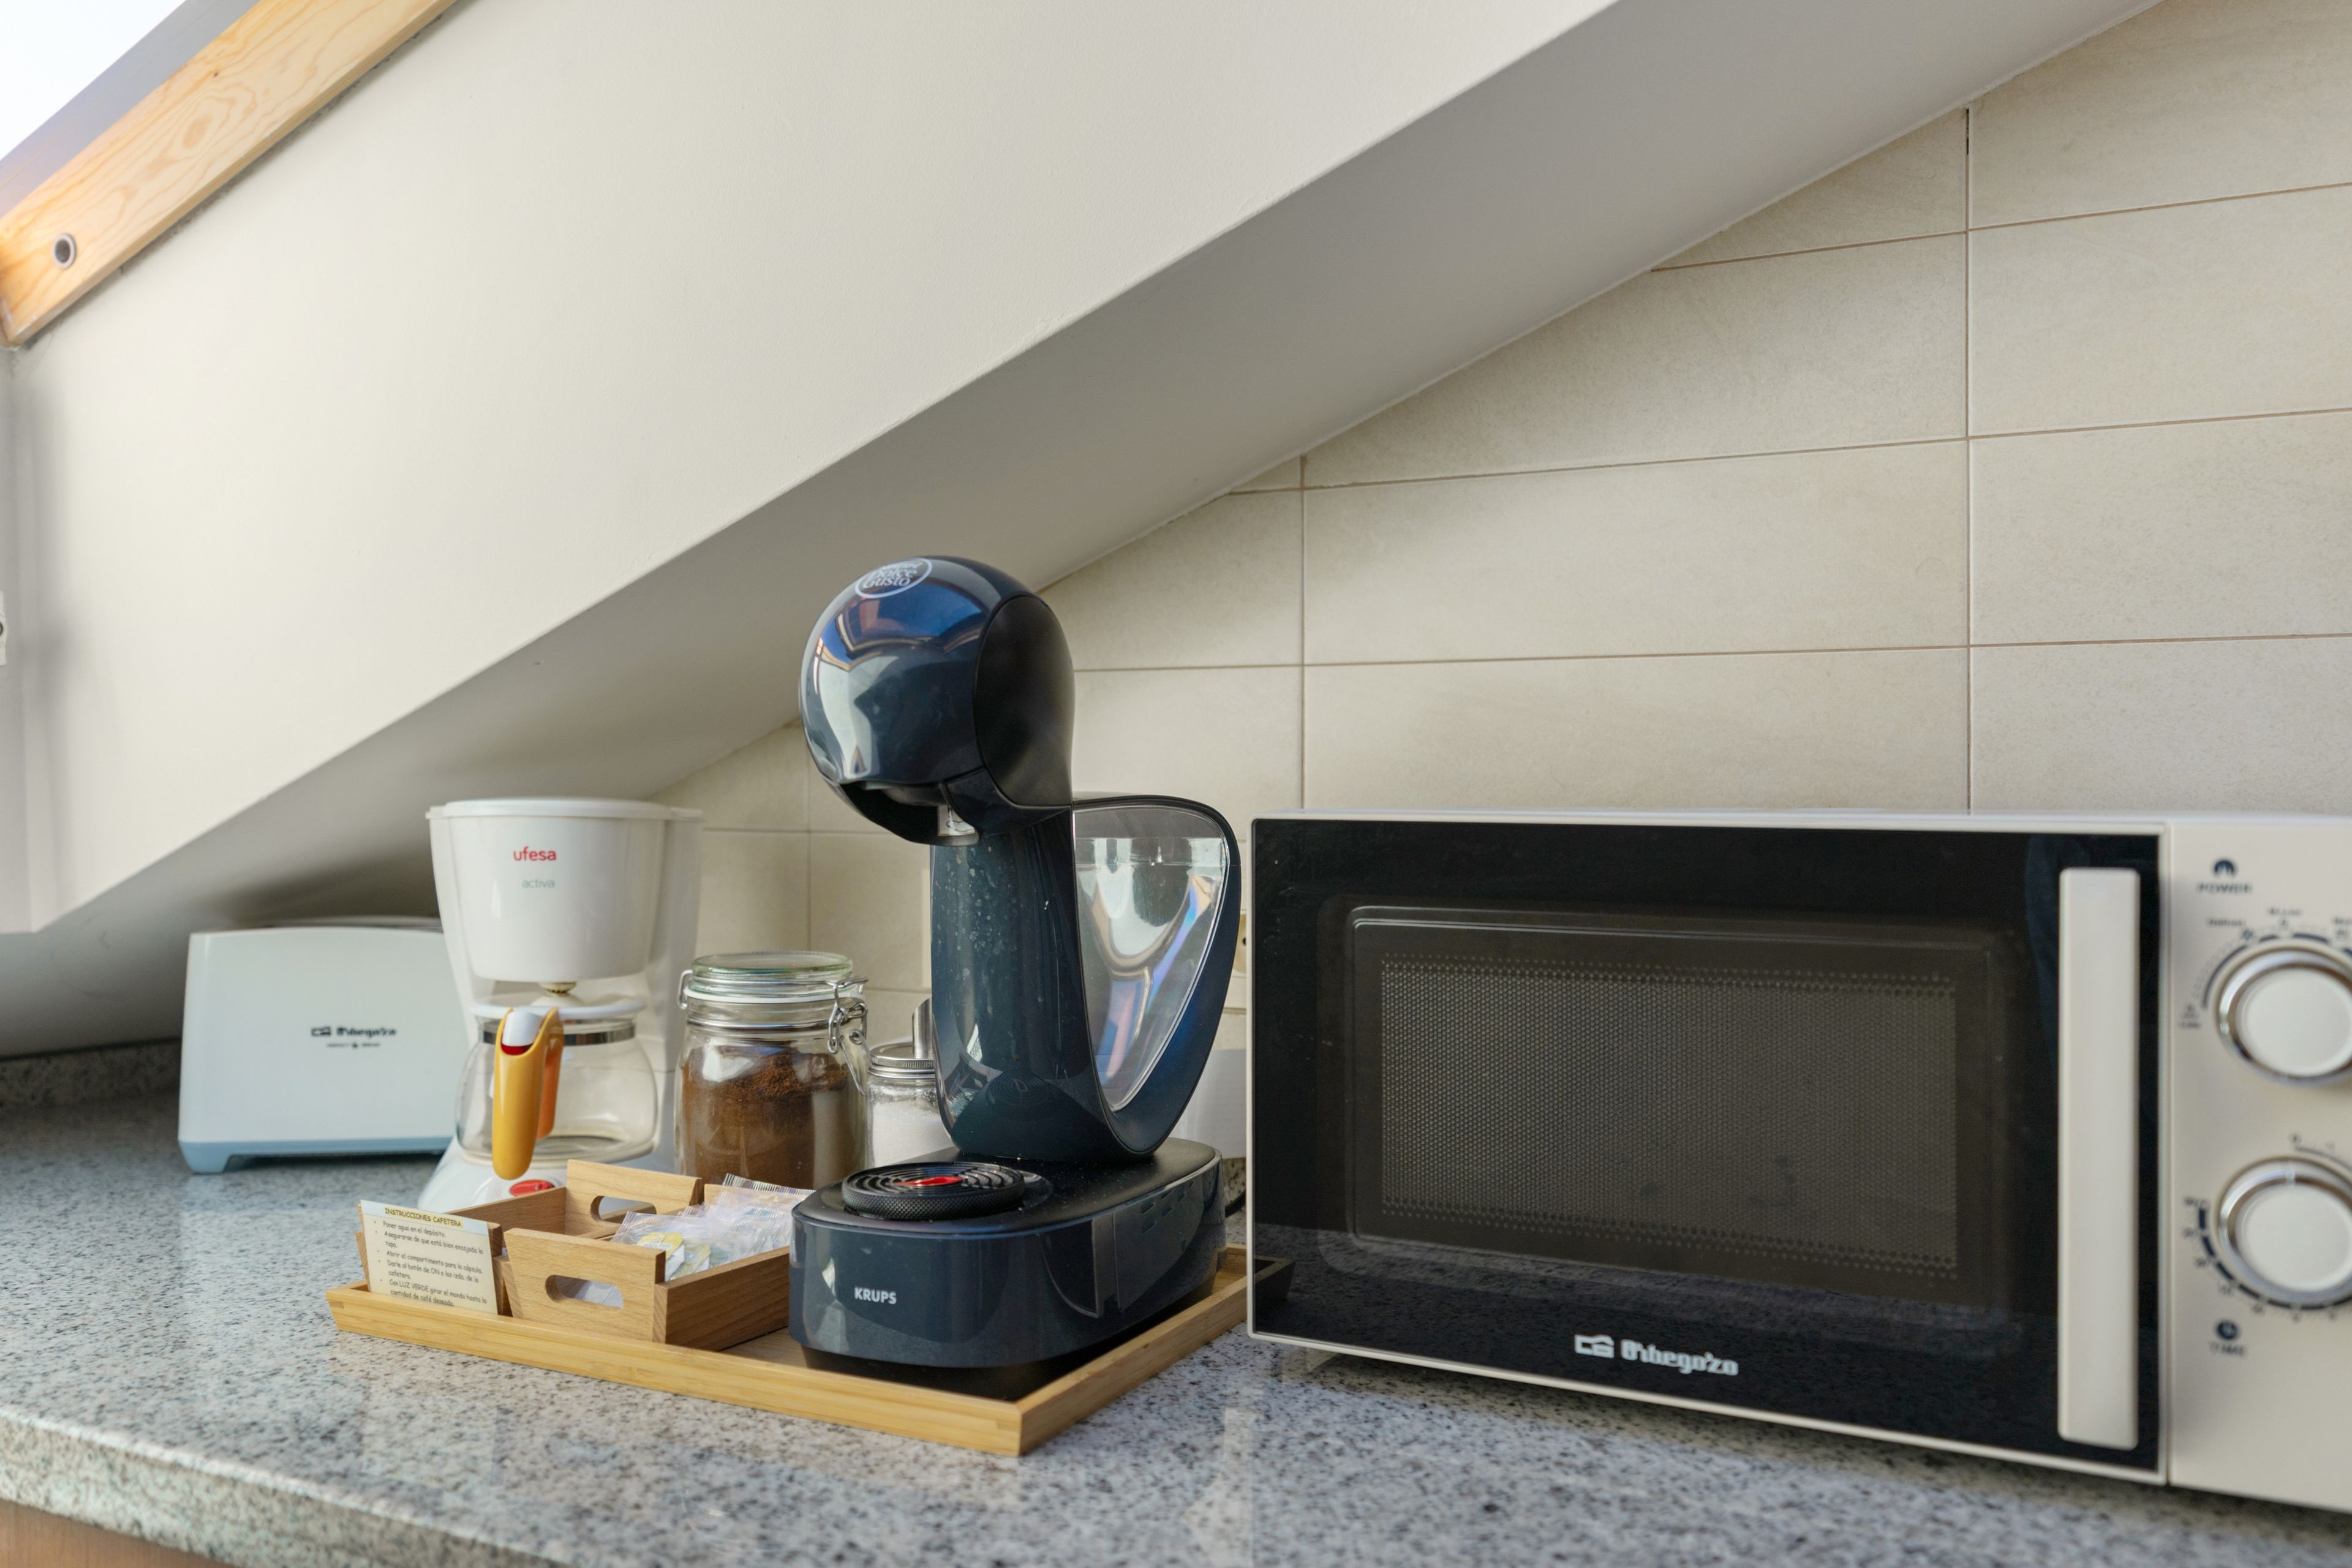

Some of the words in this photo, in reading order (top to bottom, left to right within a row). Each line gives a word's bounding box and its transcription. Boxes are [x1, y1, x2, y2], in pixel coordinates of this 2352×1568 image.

[513, 846, 556, 861] ufesa
[521, 880, 556, 888] activa
[385, 1207, 431, 1221] INSTRUCCIONES
[432, 1216, 462, 1227] CAFETERA
[382, 1220, 397, 1229] Poner
[385, 1231, 412, 1241] Asegurarse
[455, 1245, 478, 1254] encajada
[387, 1259, 401, 1268] Darle
[408, 1263, 423, 1272] botón
[407, 1255, 444, 1267] compartimento
[390, 1290, 412, 1298] cantidad
[412, 1283, 429, 1292] VERDE
[466, 1294, 481, 1303] hasta
[854, 1287, 897, 1305] KRUPS
